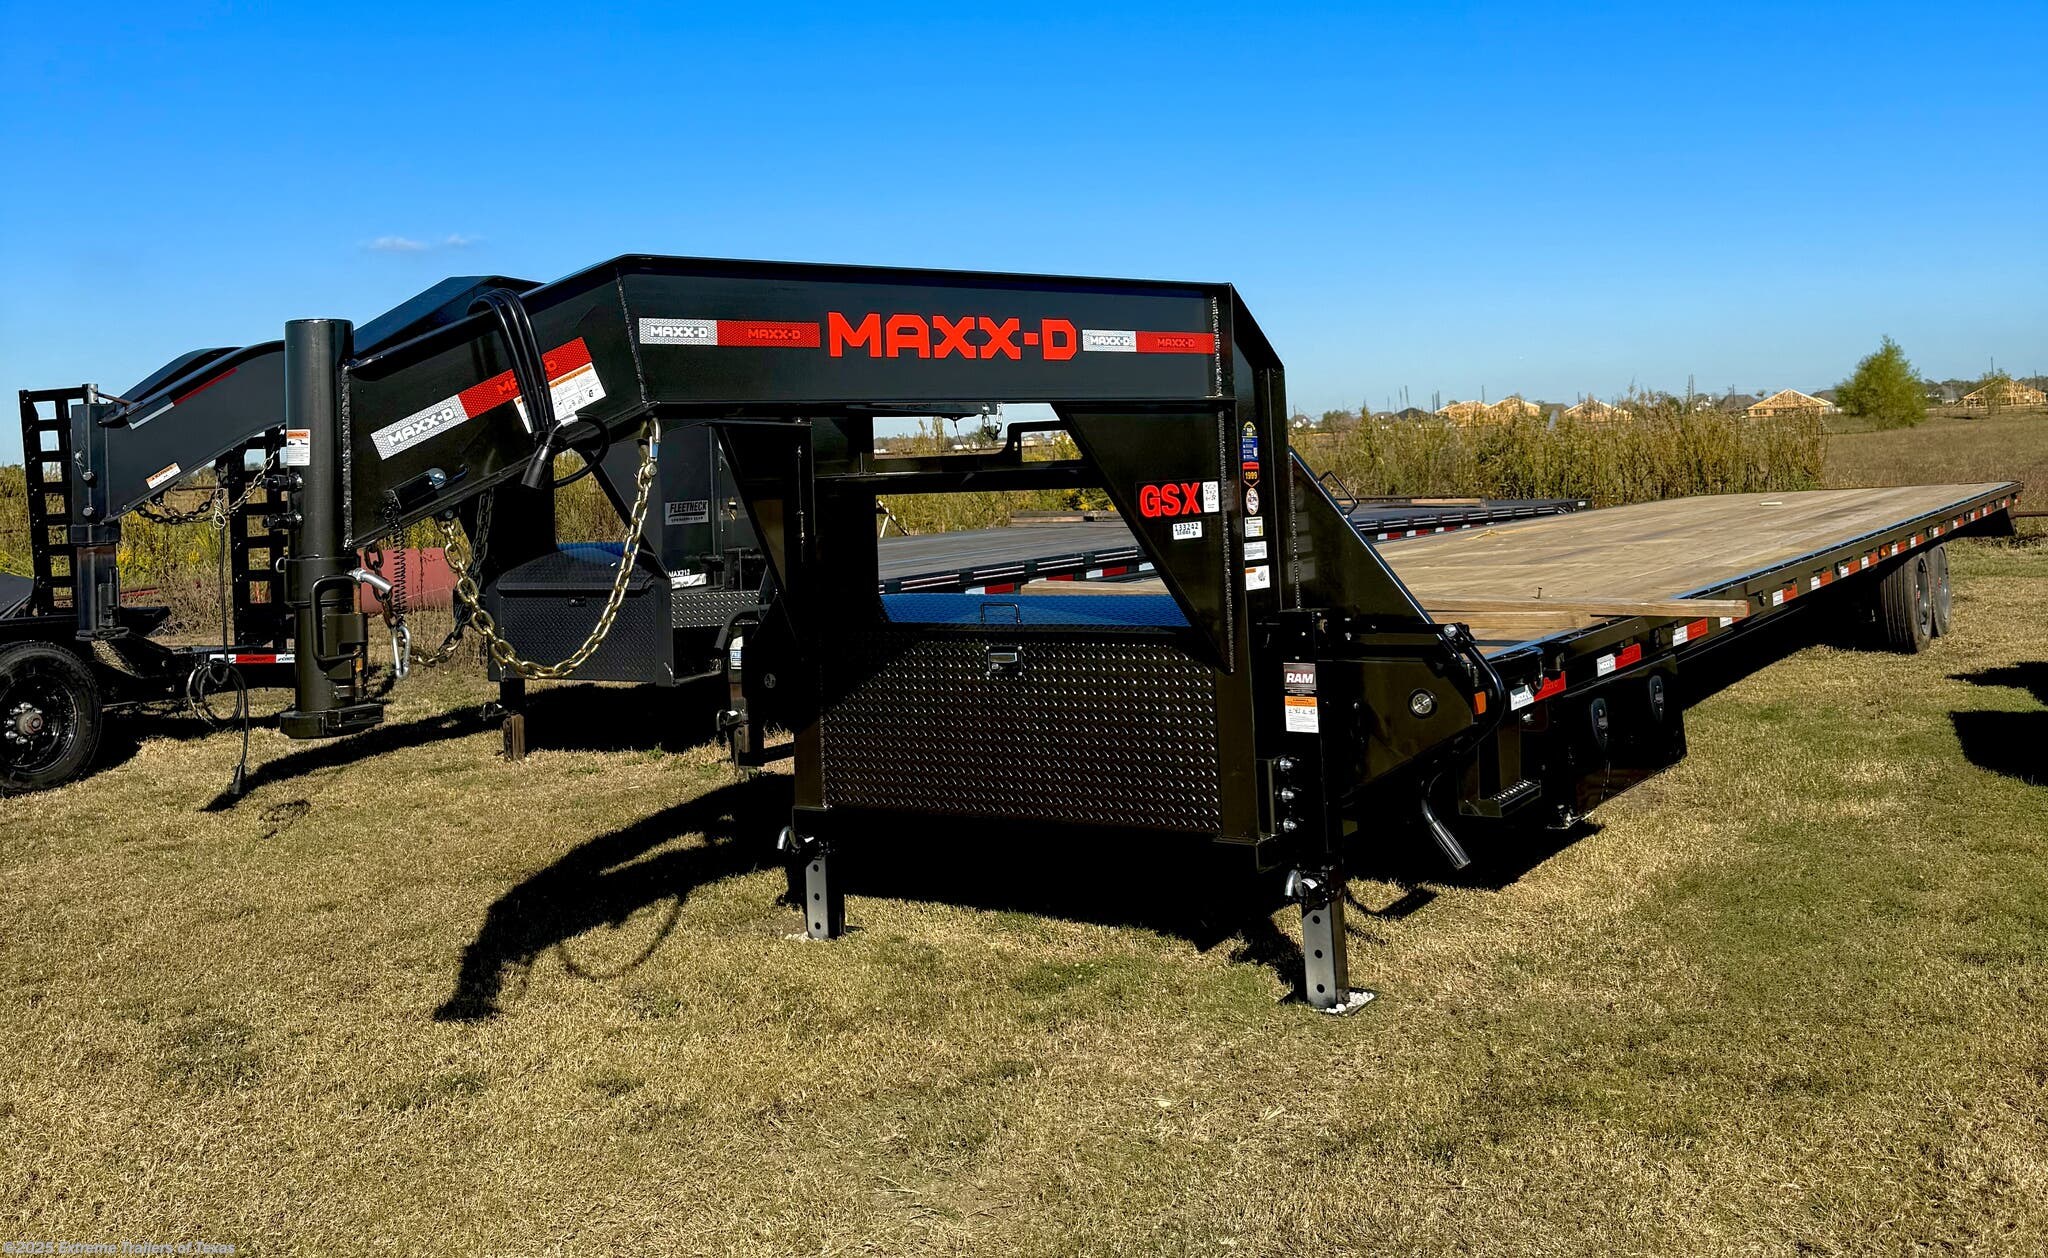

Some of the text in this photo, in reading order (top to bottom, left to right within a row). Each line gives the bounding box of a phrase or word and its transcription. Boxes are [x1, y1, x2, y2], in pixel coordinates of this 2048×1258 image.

[650, 326, 708, 338] MAXX-D
[748, 328, 801, 340] MAXX-D
[828, 311, 1078, 361] MAXX-D
[1090, 335, 1130, 346] MAXX-D
[1157, 336, 1195, 348] MAXX-D
[386, 406, 456, 447] MAXX-D
[1140, 482, 1202, 518] GSX
[670, 501, 707, 514] FLEETNECK
[1286, 673, 1313, 684] RAM
